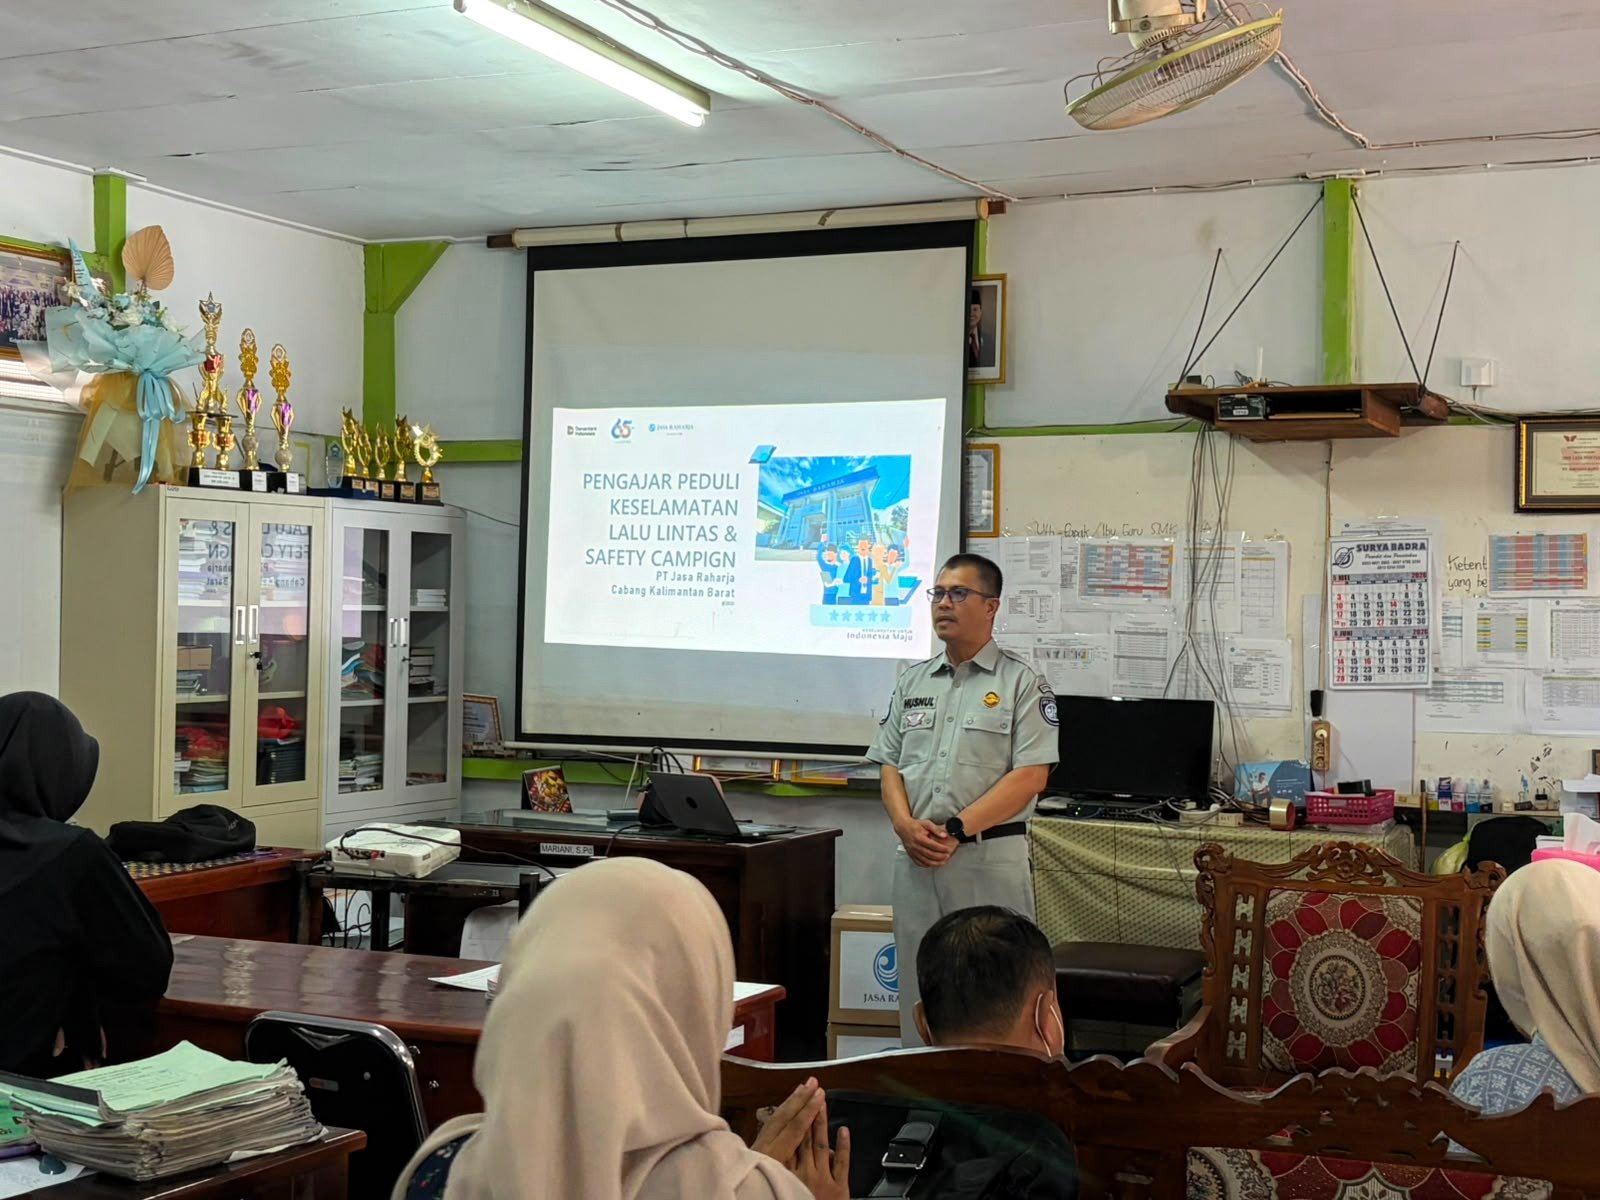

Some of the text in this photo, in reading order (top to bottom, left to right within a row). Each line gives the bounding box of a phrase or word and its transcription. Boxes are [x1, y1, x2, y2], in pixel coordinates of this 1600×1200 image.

[583, 473, 740, 490] PENGAJAR PEDULI
[610, 499, 738, 516] KESELAMATAN
[609, 524, 737, 542] LALU LINTAS &
[1122, 524, 1144, 537] Guru
[1356, 542, 1426, 552] SURYA BADRA
[585, 548, 736, 568] SAFETY CAMPIGN
[656, 571, 735, 585] PT Jasa Raharja
[611, 584, 735, 598] Cabang Kalimantan Barat
[1448, 578, 1472, 593] yang
[847, 632, 913, 642] Indonesia Maju
[1405, 648, 1411, 656] 12
[904, 697, 934, 709] HUSNUL
[864, 994, 900, 1003] JASA RA
